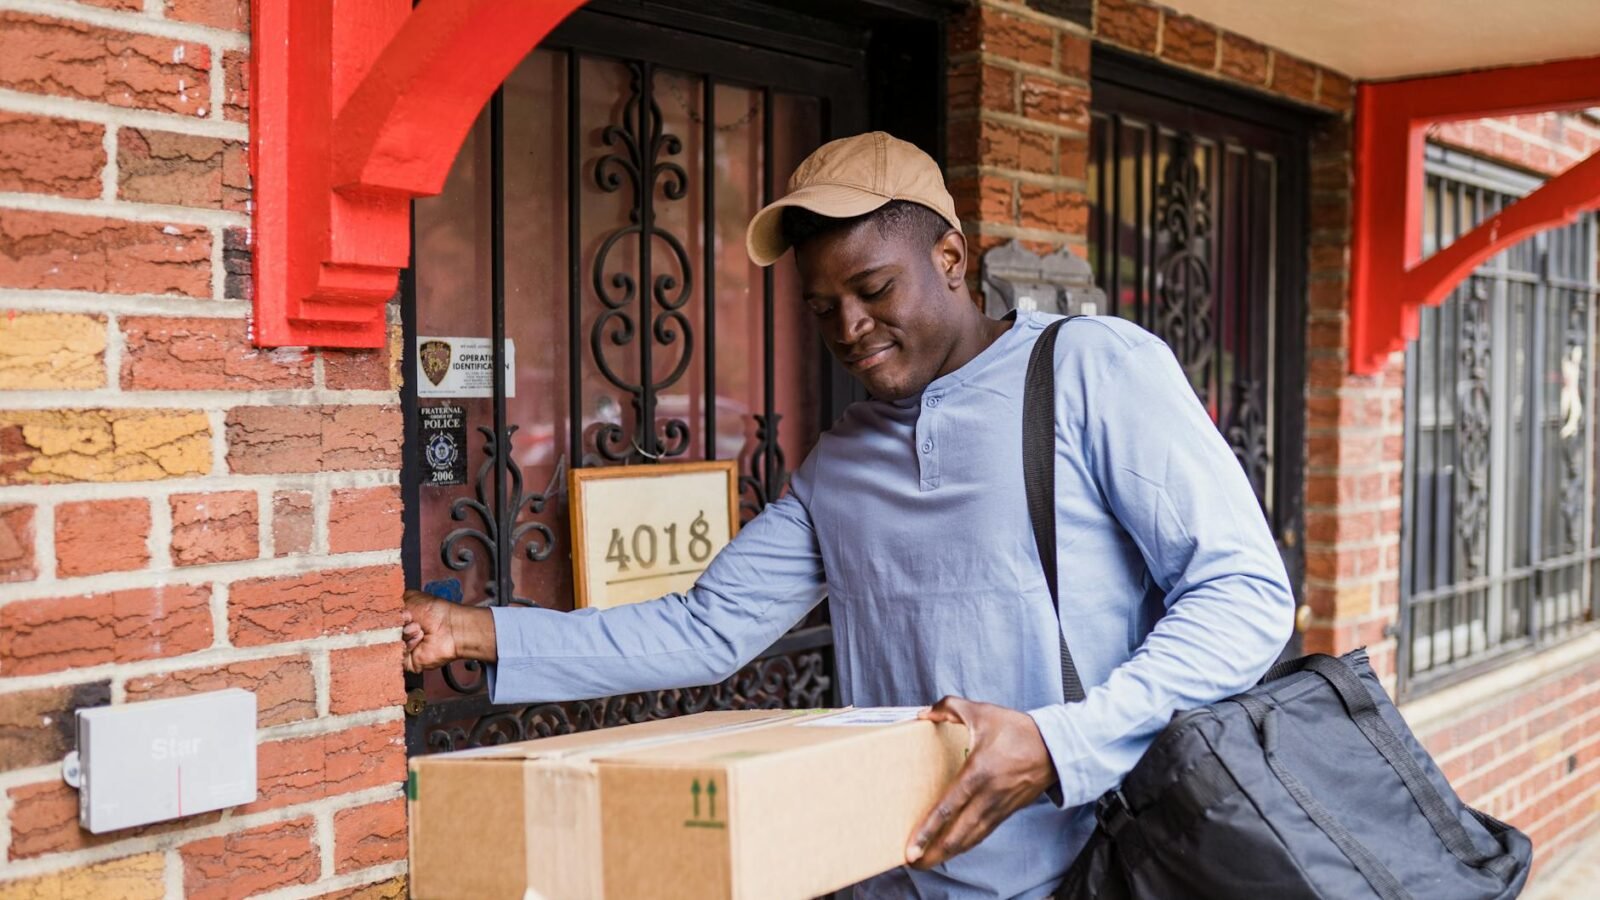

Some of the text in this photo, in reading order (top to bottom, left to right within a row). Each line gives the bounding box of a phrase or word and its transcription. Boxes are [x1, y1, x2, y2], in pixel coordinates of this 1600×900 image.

[459, 354, 494, 362] OPERATI
[453, 363, 510, 371] IDENTIFICAN
[421, 407, 462, 415] FRATERNAL
[424, 419, 461, 429] POLICE
[432, 470, 454, 482] 2006
[605, 510, 712, 572] 4018
